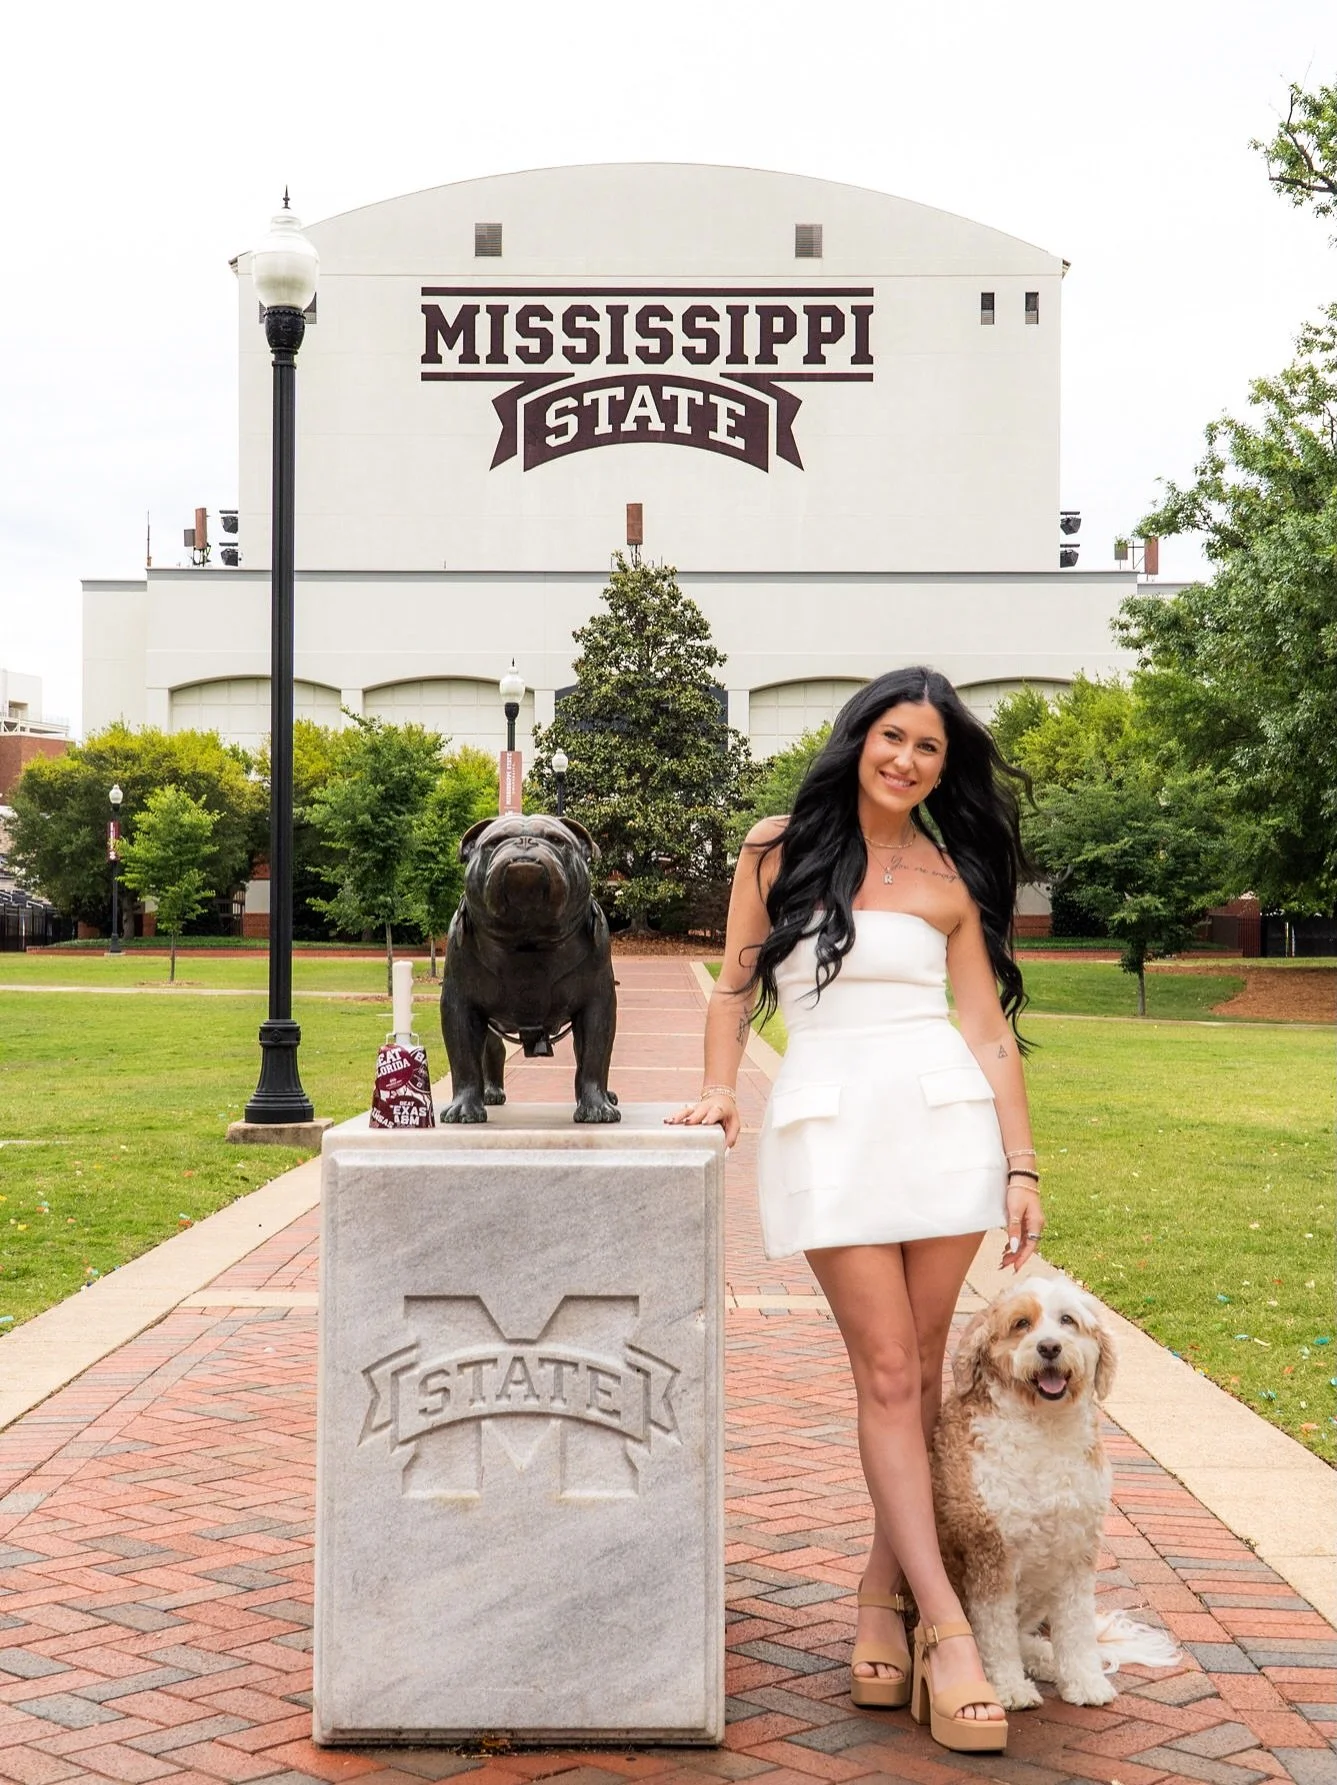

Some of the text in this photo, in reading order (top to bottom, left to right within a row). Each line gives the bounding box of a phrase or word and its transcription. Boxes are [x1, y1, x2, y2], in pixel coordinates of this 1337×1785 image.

[421, 304, 874, 365] MISSISSIPPI
[545, 385, 747, 451] STATE
[377, 1048, 402, 1067] EAT
[377, 1058, 411, 1078] LORIDA
[418, 1356, 622, 1419] STATE
